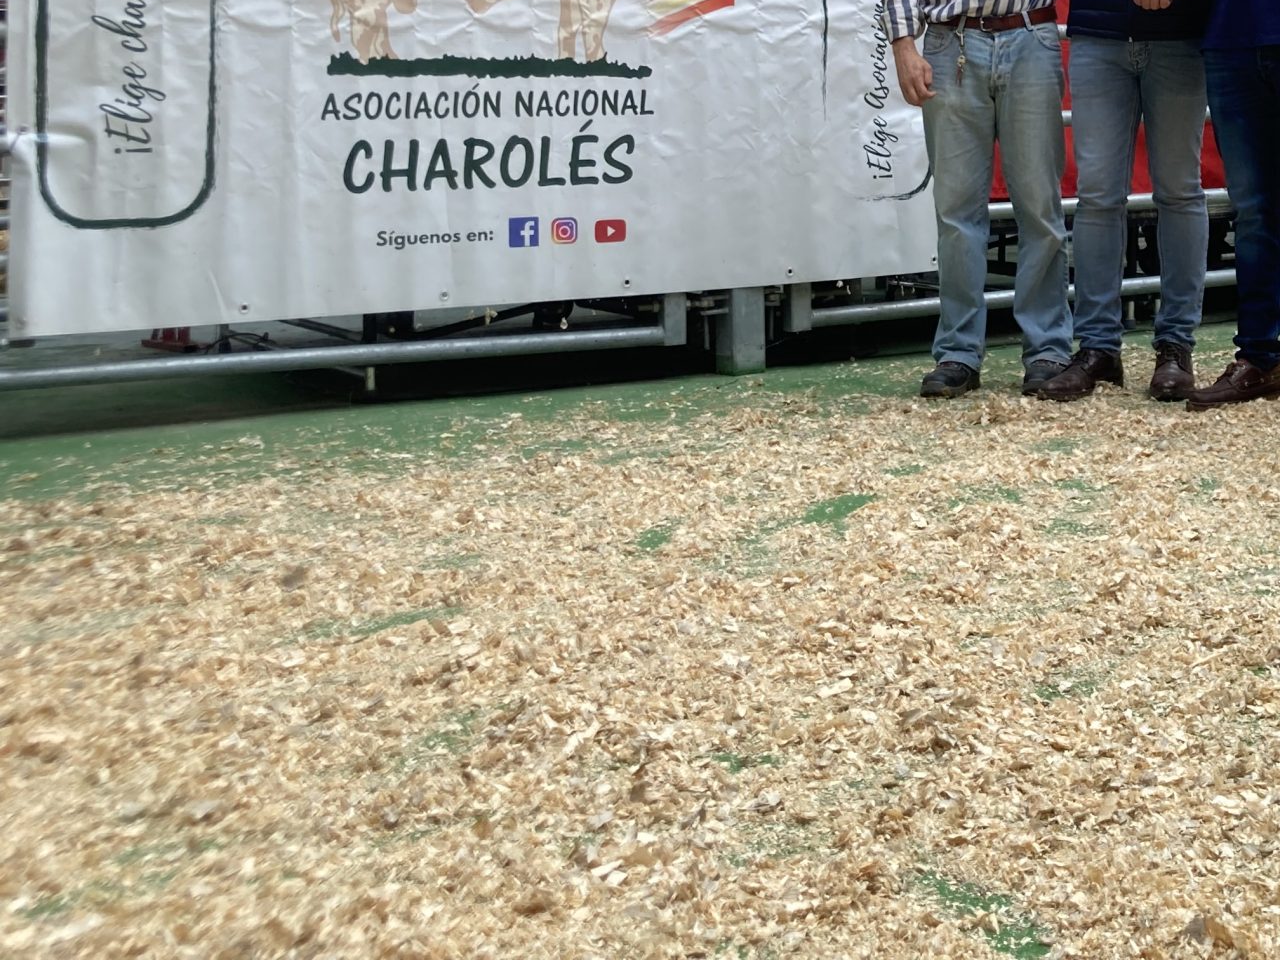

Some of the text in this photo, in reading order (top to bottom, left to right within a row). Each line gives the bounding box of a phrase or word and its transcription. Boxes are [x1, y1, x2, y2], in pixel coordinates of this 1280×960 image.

[99, 61, 167, 154] ¡Elige
[321, 82, 655, 122] ASOCIACIÓN NACIONAL
[342, 118, 636, 195] CHAROLÉS
[862, 115, 899, 180] ¡Elige
[375, 228, 494, 251] Síguenos en:
